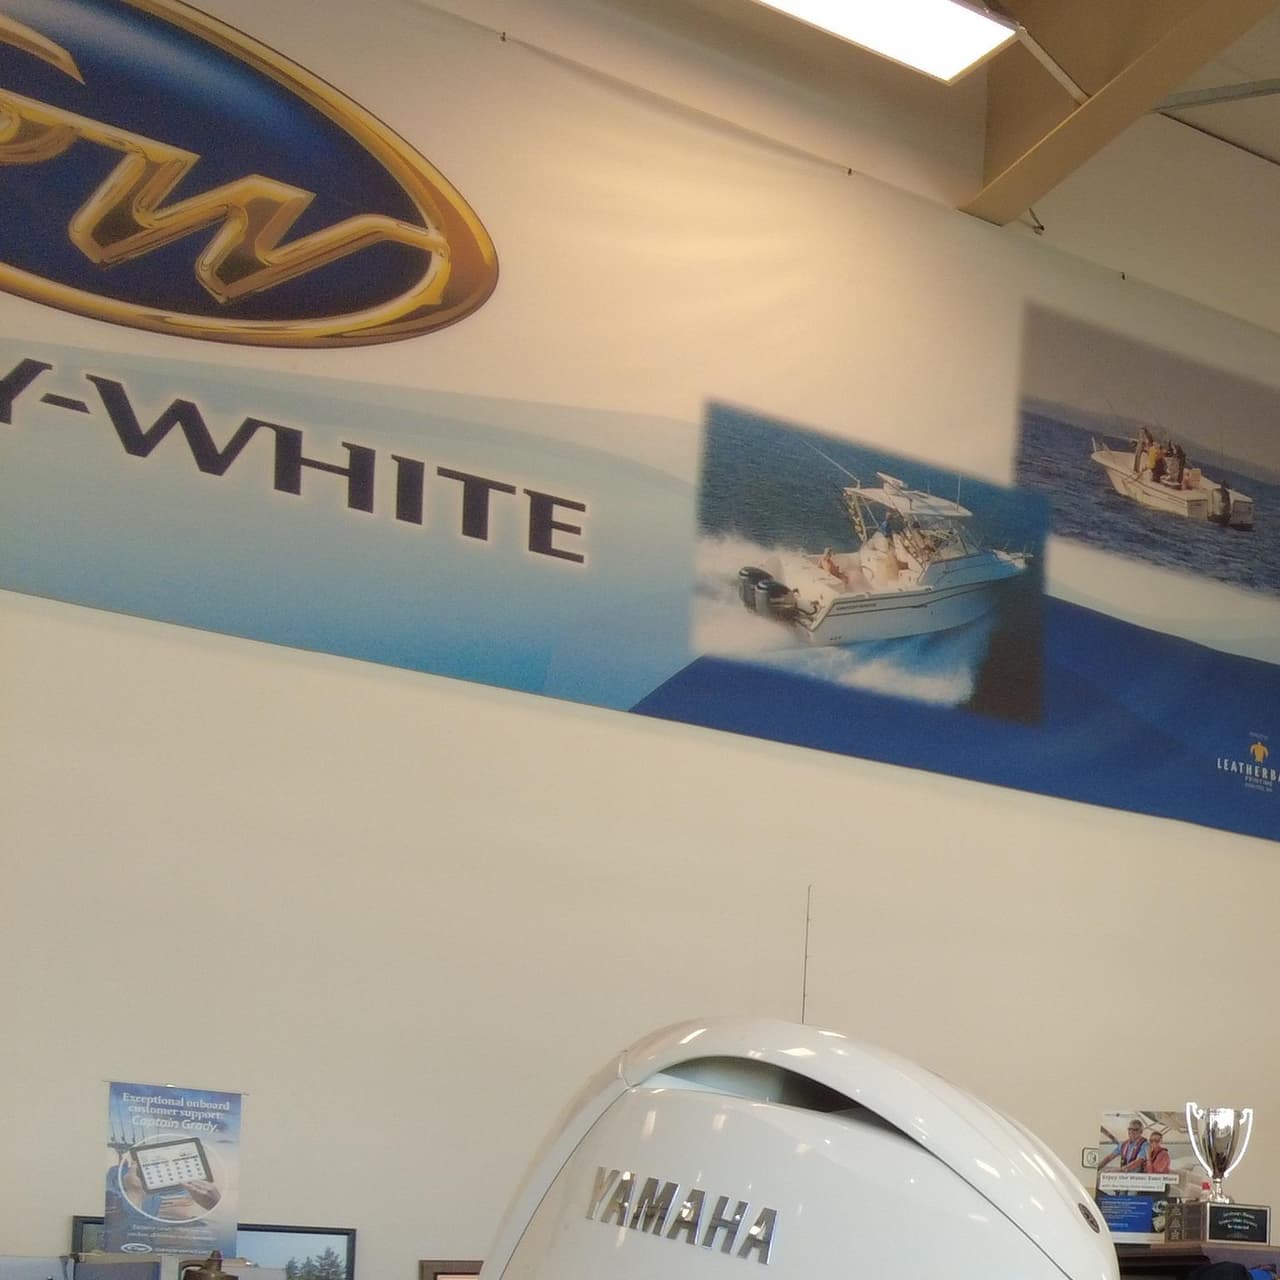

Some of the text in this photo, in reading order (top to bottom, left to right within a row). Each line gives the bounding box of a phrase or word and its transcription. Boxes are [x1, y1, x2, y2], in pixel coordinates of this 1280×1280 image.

[122, 1092, 230, 1111] Exceptional onboard
[128, 1105, 180, 1116] customer
[132, 1115, 180, 1129] Captain
[585, 1166, 777, 1266] YAMAHA
